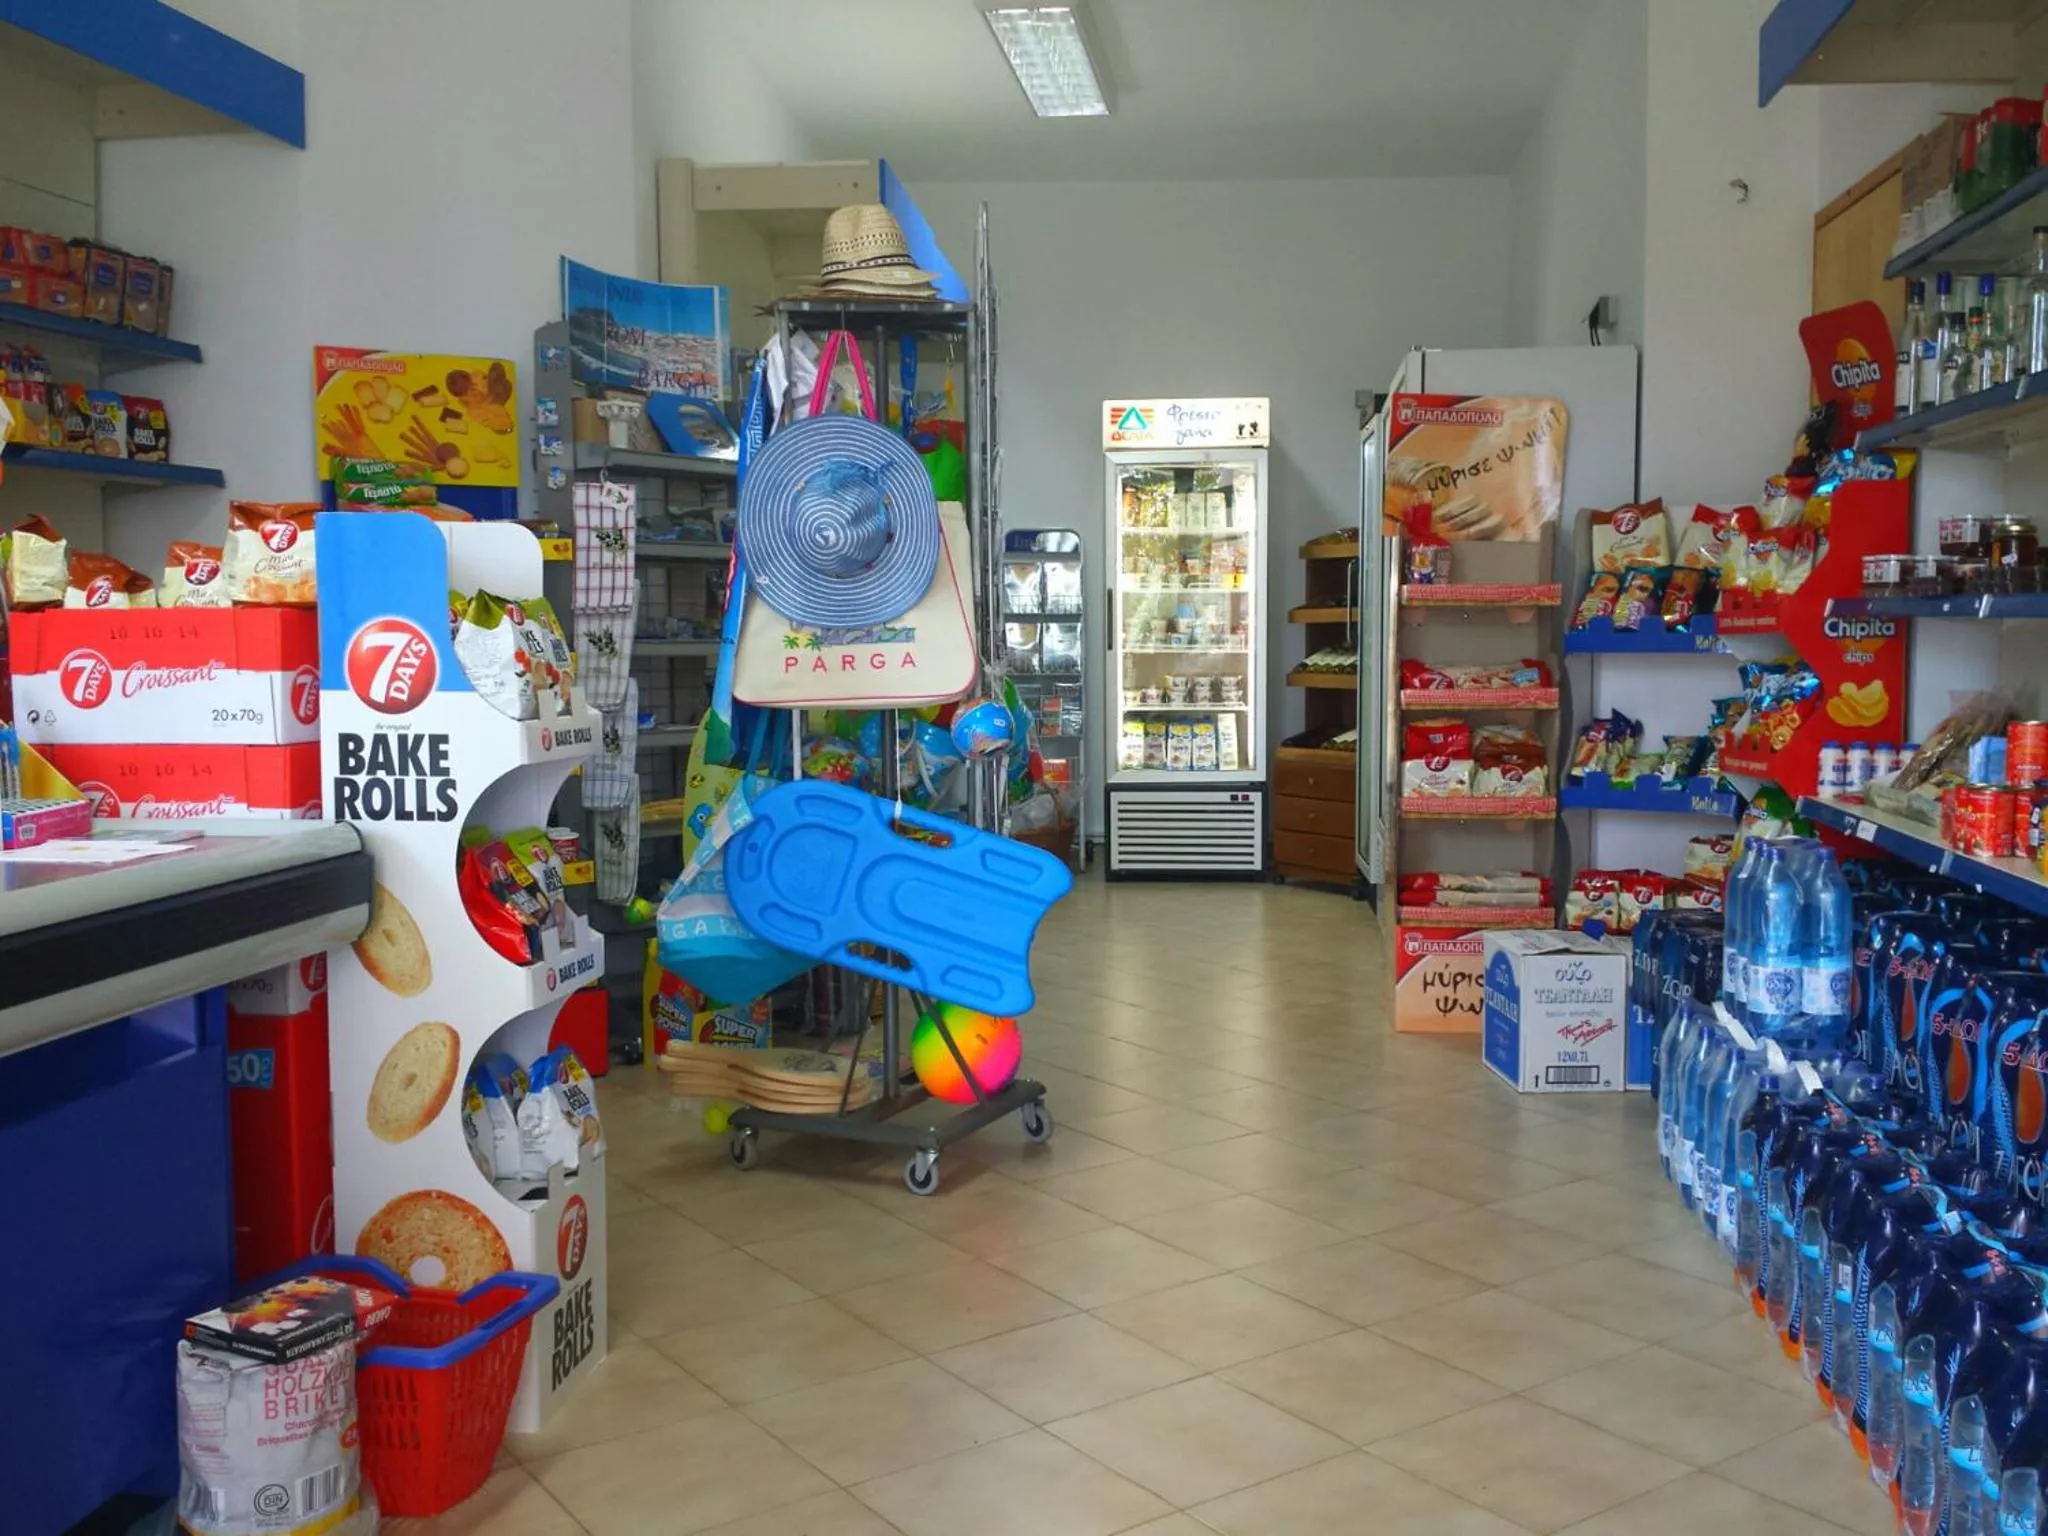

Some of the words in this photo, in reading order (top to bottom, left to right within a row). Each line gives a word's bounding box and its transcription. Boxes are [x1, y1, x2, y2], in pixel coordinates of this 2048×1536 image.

[1831, 360, 1881, 388] Chipita
[267, 523, 285, 550] 7
[1824, 616, 1896, 640] Chipita
[362, 631, 414, 705] 7
[388, 637, 429, 702] DAYS
[784, 651, 917, 673] PARGA
[1844, 649, 1874, 666] chips
[66, 657, 97, 703] 7
[84, 662, 107, 701] DAYS
[120, 658, 226, 699] Croissant
[295, 674, 313, 718] 7
[337, 732, 451, 777] BAKE
[554, 728, 573, 747] BAKE
[573, 726, 592, 744] ROLLS
[333, 776, 459, 823] ROLLS
[559, 961, 576, 983] BAKE
[577, 953, 595, 975] ROLLS
[714, 1014, 757, 1038] SUPER
[562, 1203, 580, 1273] 7
[571, 1206, 585, 1263] DAYS
[553, 1277, 592, 1350] BAKE
[551, 1314, 595, 1392] ROLLS
